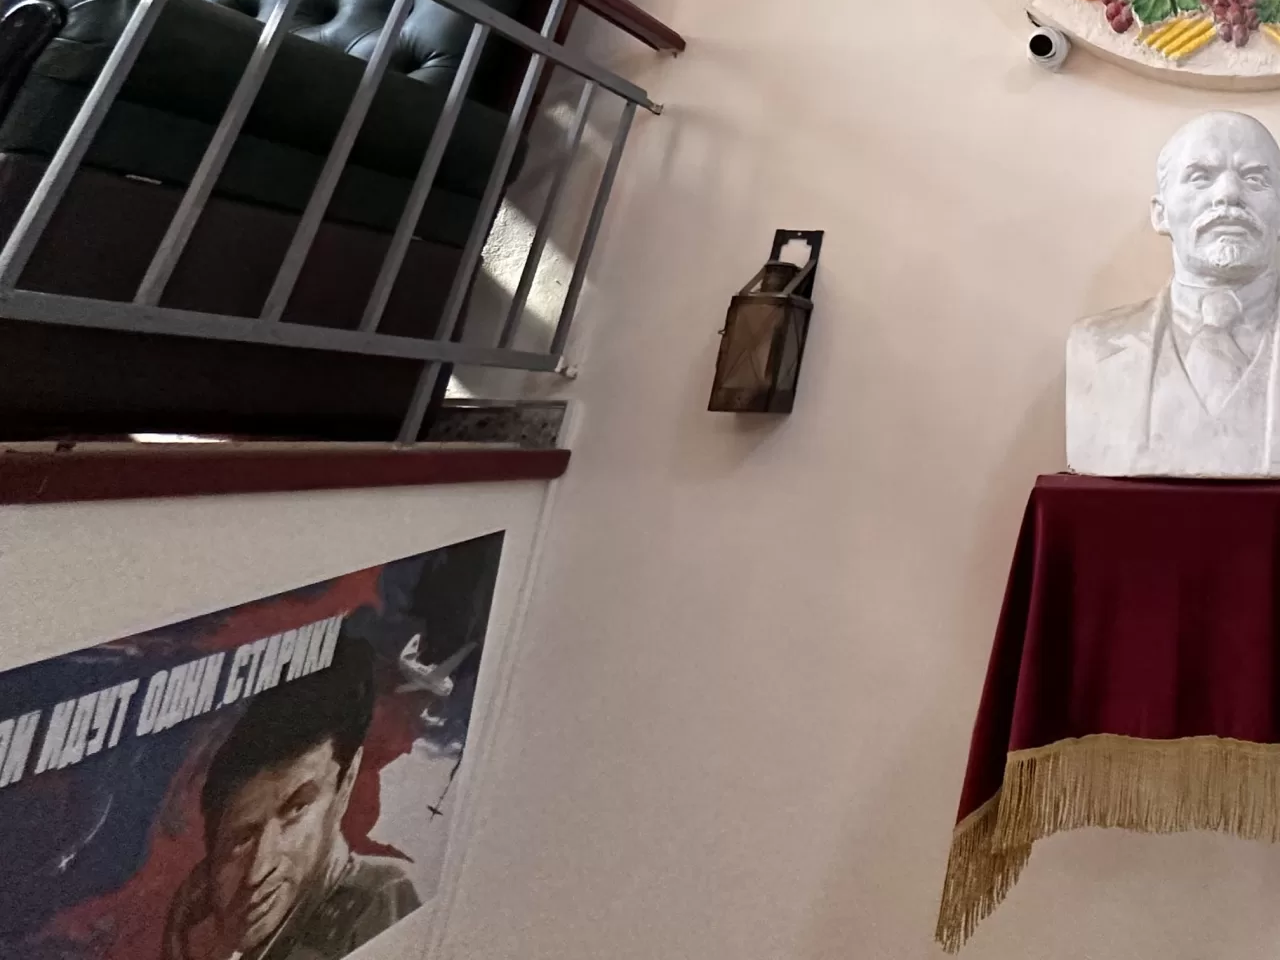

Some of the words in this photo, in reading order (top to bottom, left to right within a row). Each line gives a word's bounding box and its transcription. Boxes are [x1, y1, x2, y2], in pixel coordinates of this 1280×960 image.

[34, 678, 140, 775] ИДУТ
[136, 652, 226, 736] ОДНИ
[216, 614, 347, 710] СТАРИКИ
